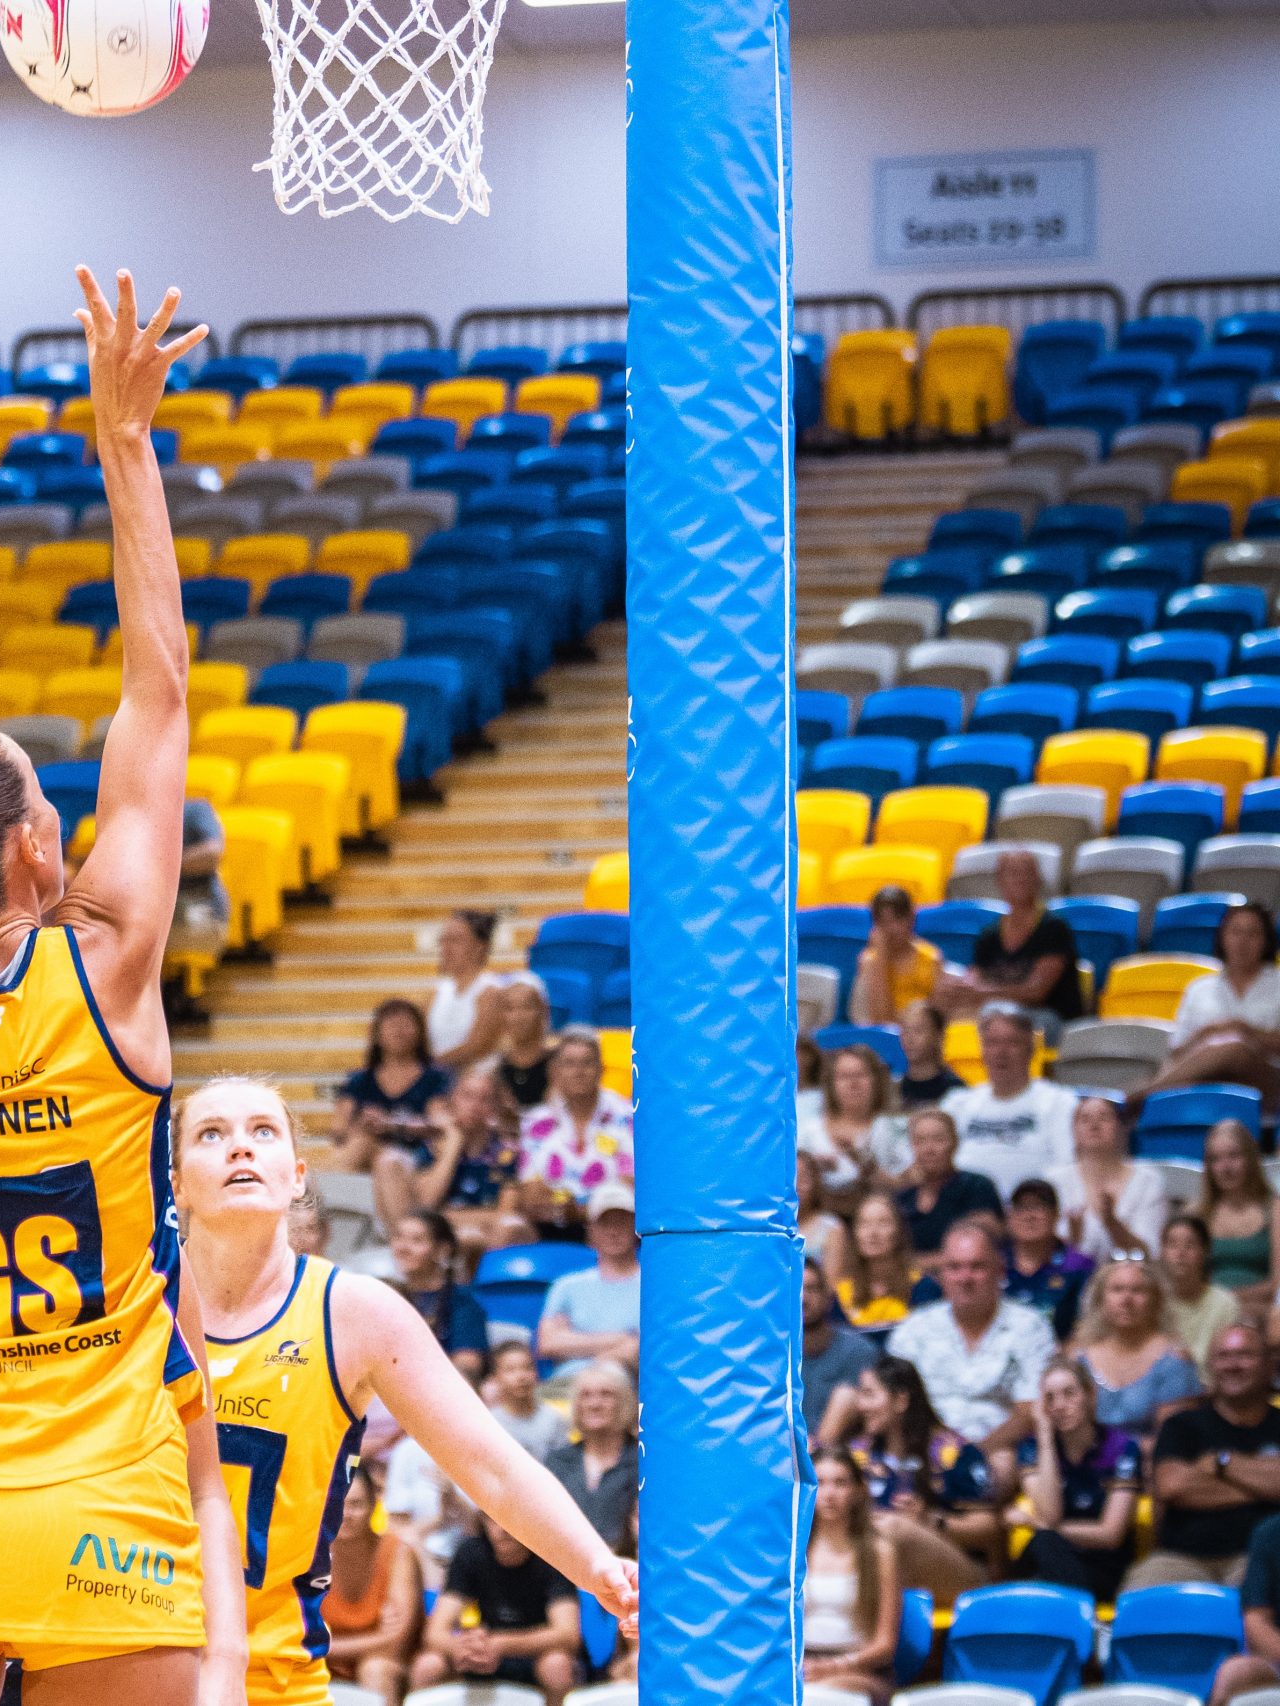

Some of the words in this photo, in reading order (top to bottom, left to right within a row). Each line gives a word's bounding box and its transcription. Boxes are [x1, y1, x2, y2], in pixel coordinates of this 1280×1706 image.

[931, 170, 1001, 198] Aisle
[903, 218, 978, 247] Seats
[64, 1328, 122, 1353] Coast
[265, 1354, 310, 1366] LIGHTNING
[69, 1533, 175, 1586] AVID
[66, 1573, 137, 1605] Property
[141, 1587, 175, 1614] Group
